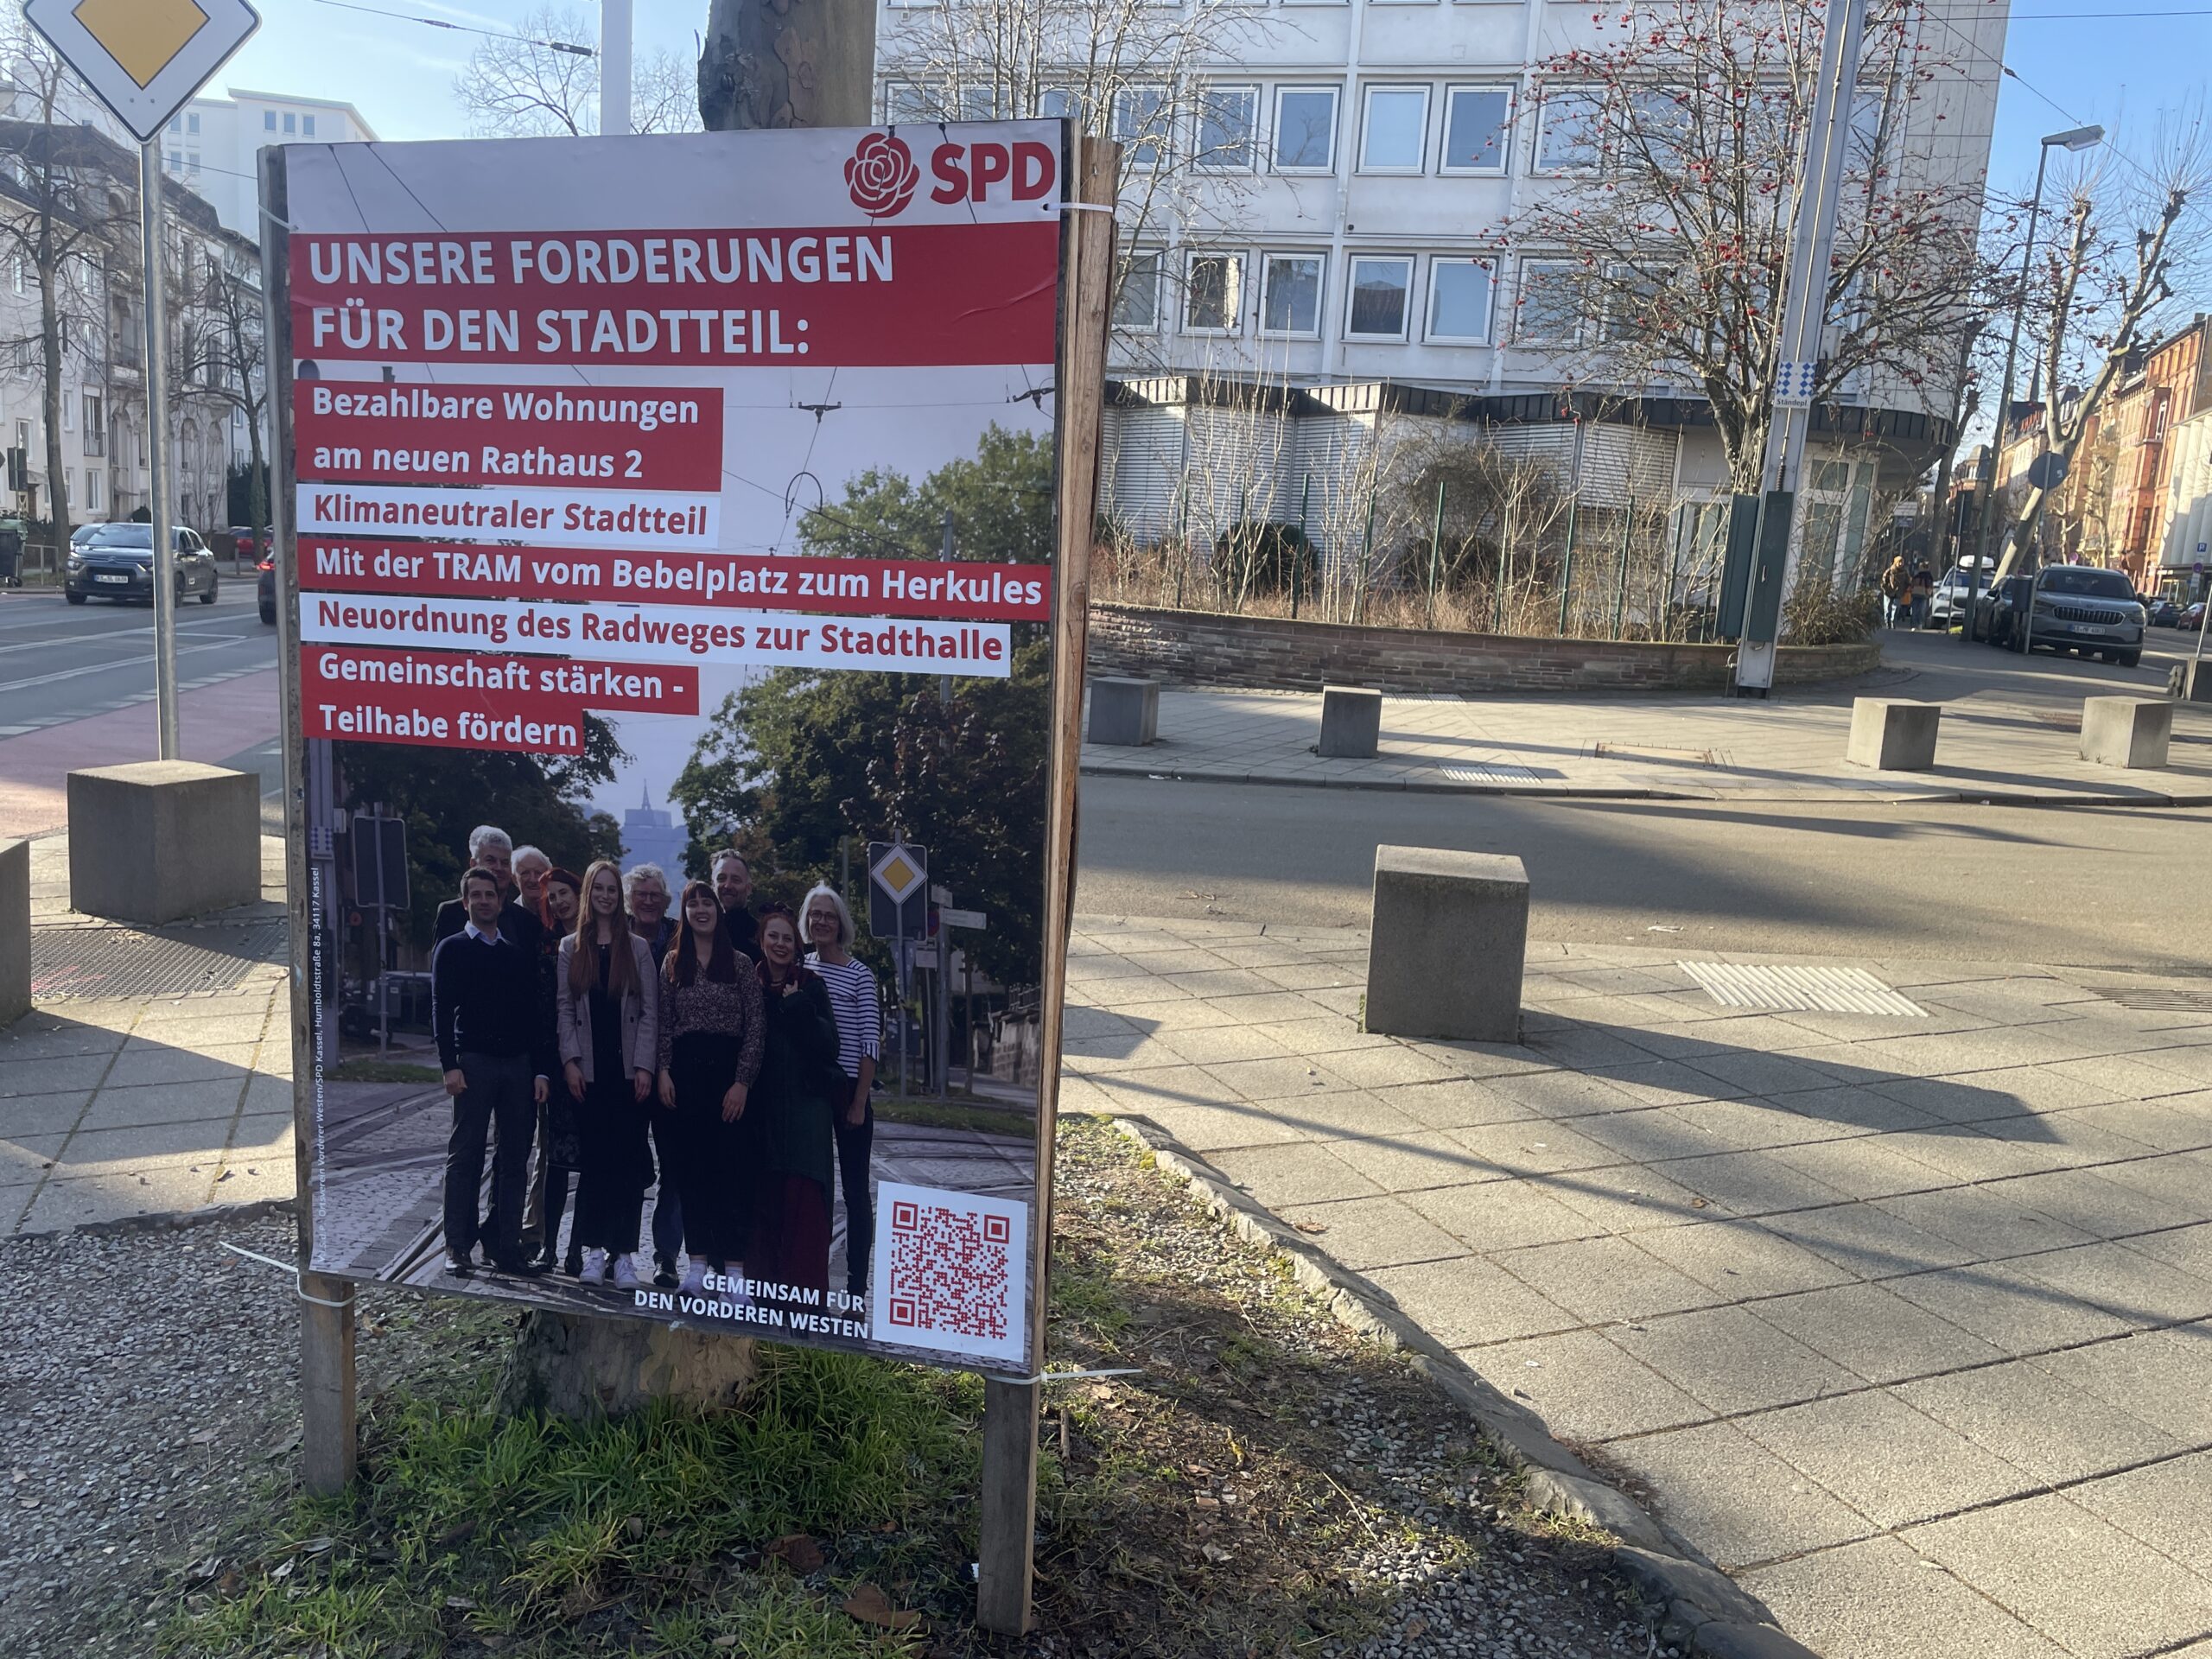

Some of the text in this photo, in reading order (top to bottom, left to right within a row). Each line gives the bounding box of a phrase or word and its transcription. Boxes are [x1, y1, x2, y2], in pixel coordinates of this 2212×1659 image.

[931, 142, 1055, 205] SPD
[309, 236, 893, 285] UNSERE FORDERUNGEN
[312, 297, 809, 354] FÜR DEN STADTTEIL:
[313, 387, 699, 430] Bezahlbare Wohnungen
[314, 446, 643, 479] am neuen Rathaus 2
[315, 493, 707, 536] Klimaneutraler Stadtteil
[315, 547, 1043, 605] Mit der TRAM vom Bebelplatz zum Herkules
[318, 600, 1002, 661] Neuordnung des Radweges zur Stadthalle
[319, 652, 531, 690] Gemeinschaft
[540, 665, 663, 699] stärken
[319, 704, 577, 747] Teilhabe fördern
[311, 868, 320, 898] Kassel
[314, 949, 322, 1027] Humboldtstraße
[315, 1031, 323, 1062] Kassel,
[315, 1065, 325, 1122] Westen/SPD
[317, 1124, 326, 1166] Vorderer
[317, 1168, 327, 1217] Ortsverein
[634, 1289, 868, 1339] DEN VORDEREN WESTEN
[702, 1274, 865, 1313] GEMEINSAM FÜR
